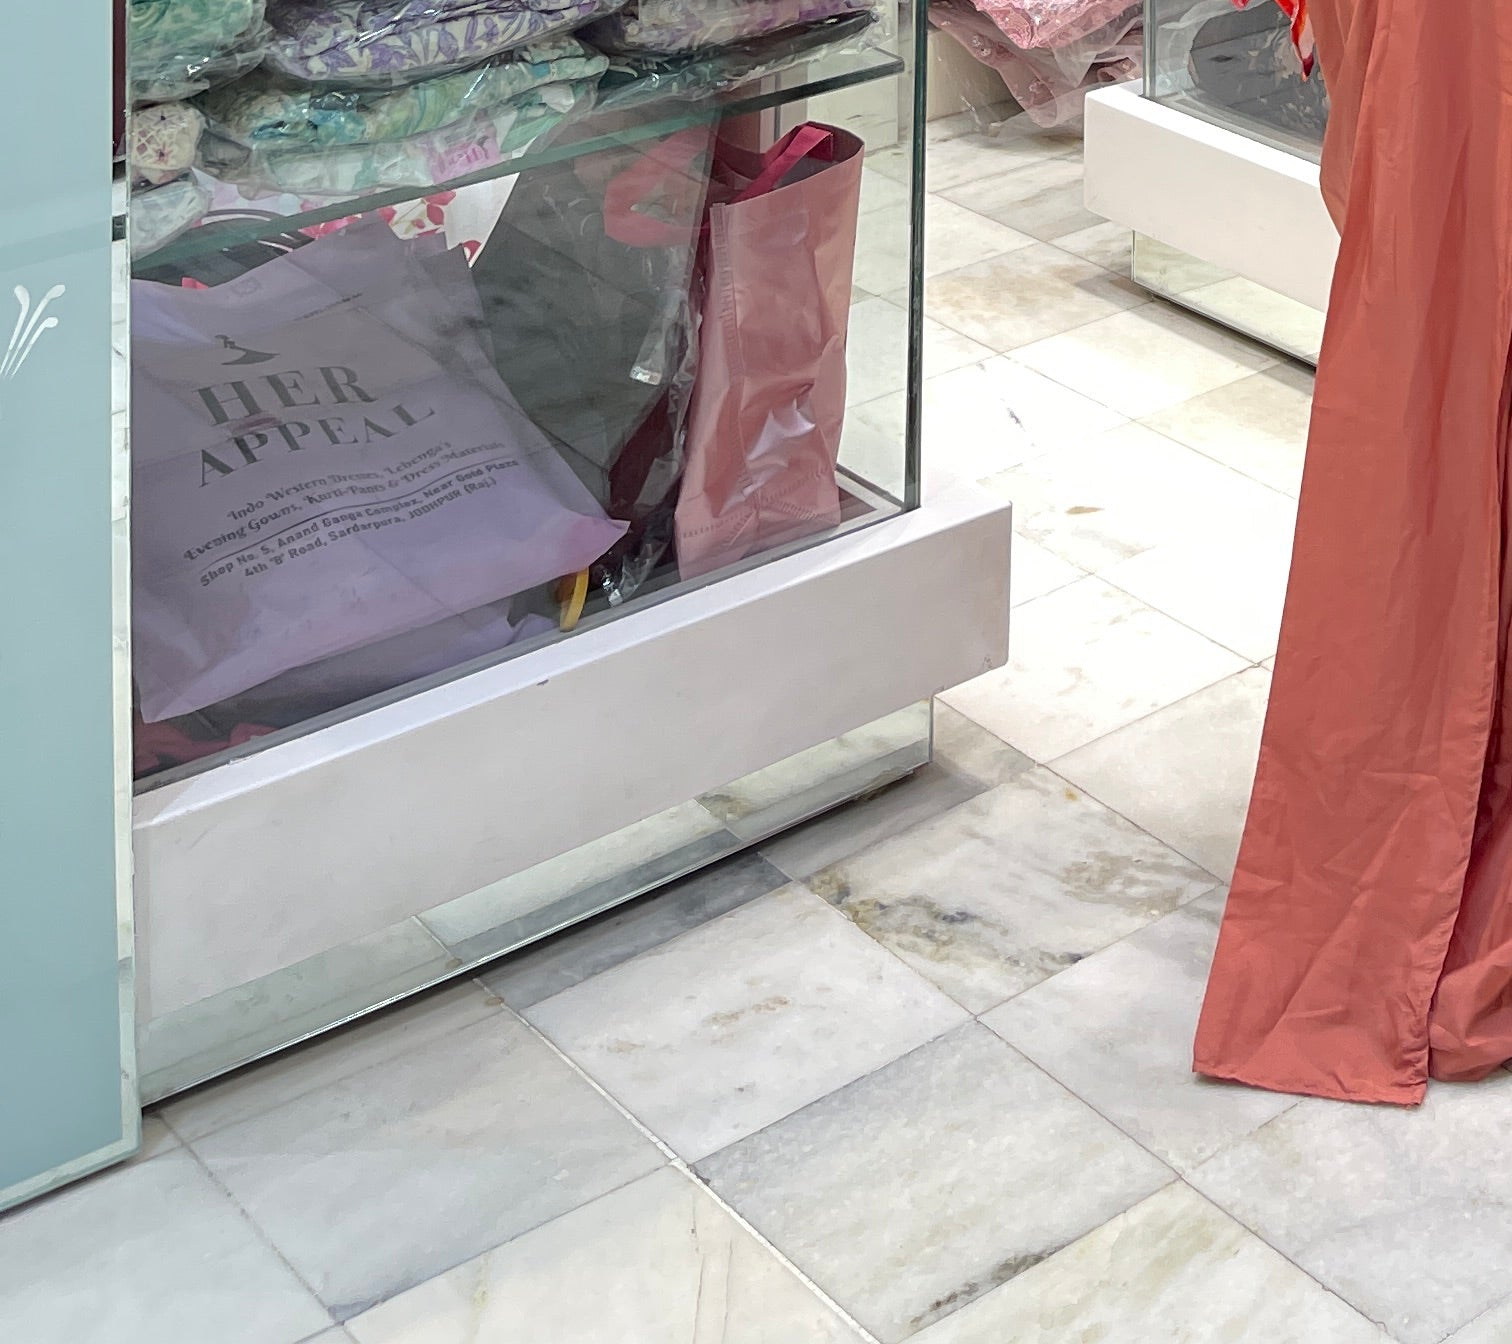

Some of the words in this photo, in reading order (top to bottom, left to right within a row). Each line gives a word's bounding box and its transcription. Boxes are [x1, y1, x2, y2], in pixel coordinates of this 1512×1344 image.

[193, 365, 378, 427] HER
[199, 403, 435, 488] APPEAL
[184, 526, 248, 560] Evening
[199, 560, 234, 587] Shop
[277, 520, 320, 548] Anand
[321, 511, 363, 528] Ganga
[422, 477, 454, 499] Near
[244, 562, 269, 578] 4th
[407, 488, 463, 519] JODHPUR
